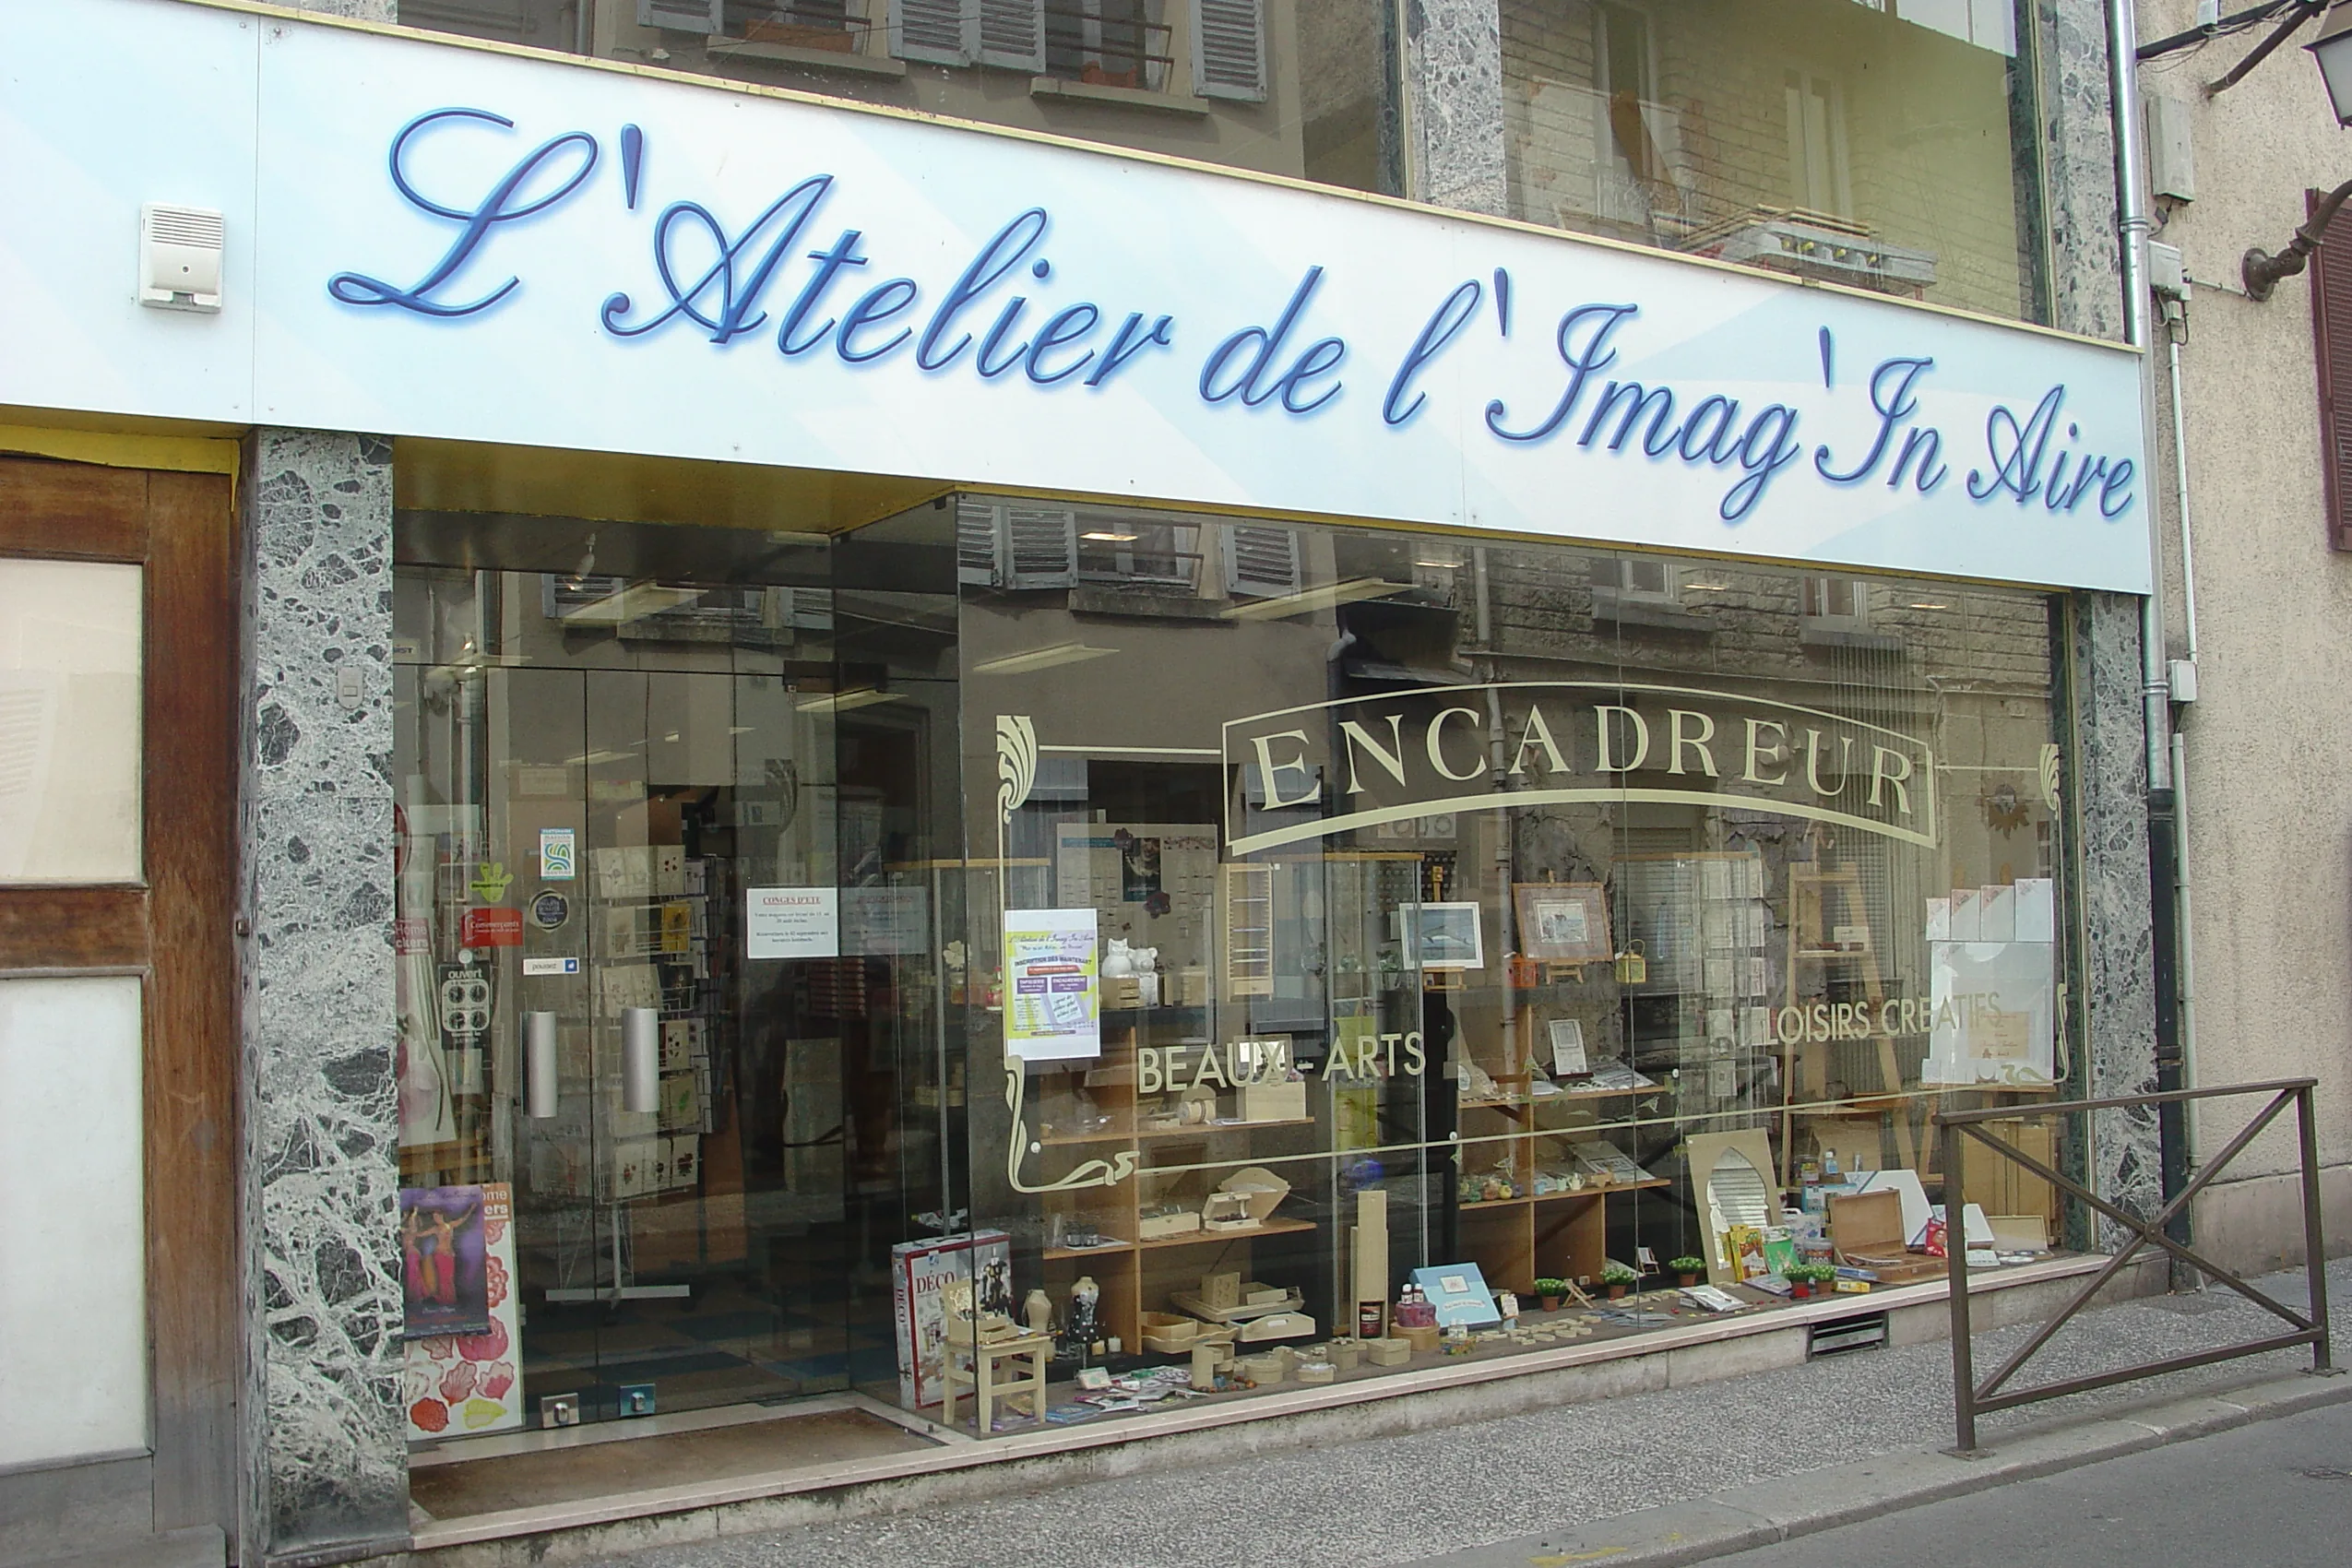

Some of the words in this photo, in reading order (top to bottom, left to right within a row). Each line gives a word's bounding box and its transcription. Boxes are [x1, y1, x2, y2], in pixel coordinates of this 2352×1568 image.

[327, 106, 1173, 387] L'Atelier
[1198, 265, 1345, 413] de
[1966, 383, 2134, 518] Aire
[1250, 704, 1913, 814] ENCADREUR
[448, 968, 482, 979] ouvert
[1764, 1000, 1871, 1045] LOISIRS
[1881, 991, 2002, 1037] CREATIFS
[916, 1270, 956, 1294] DÉCO
